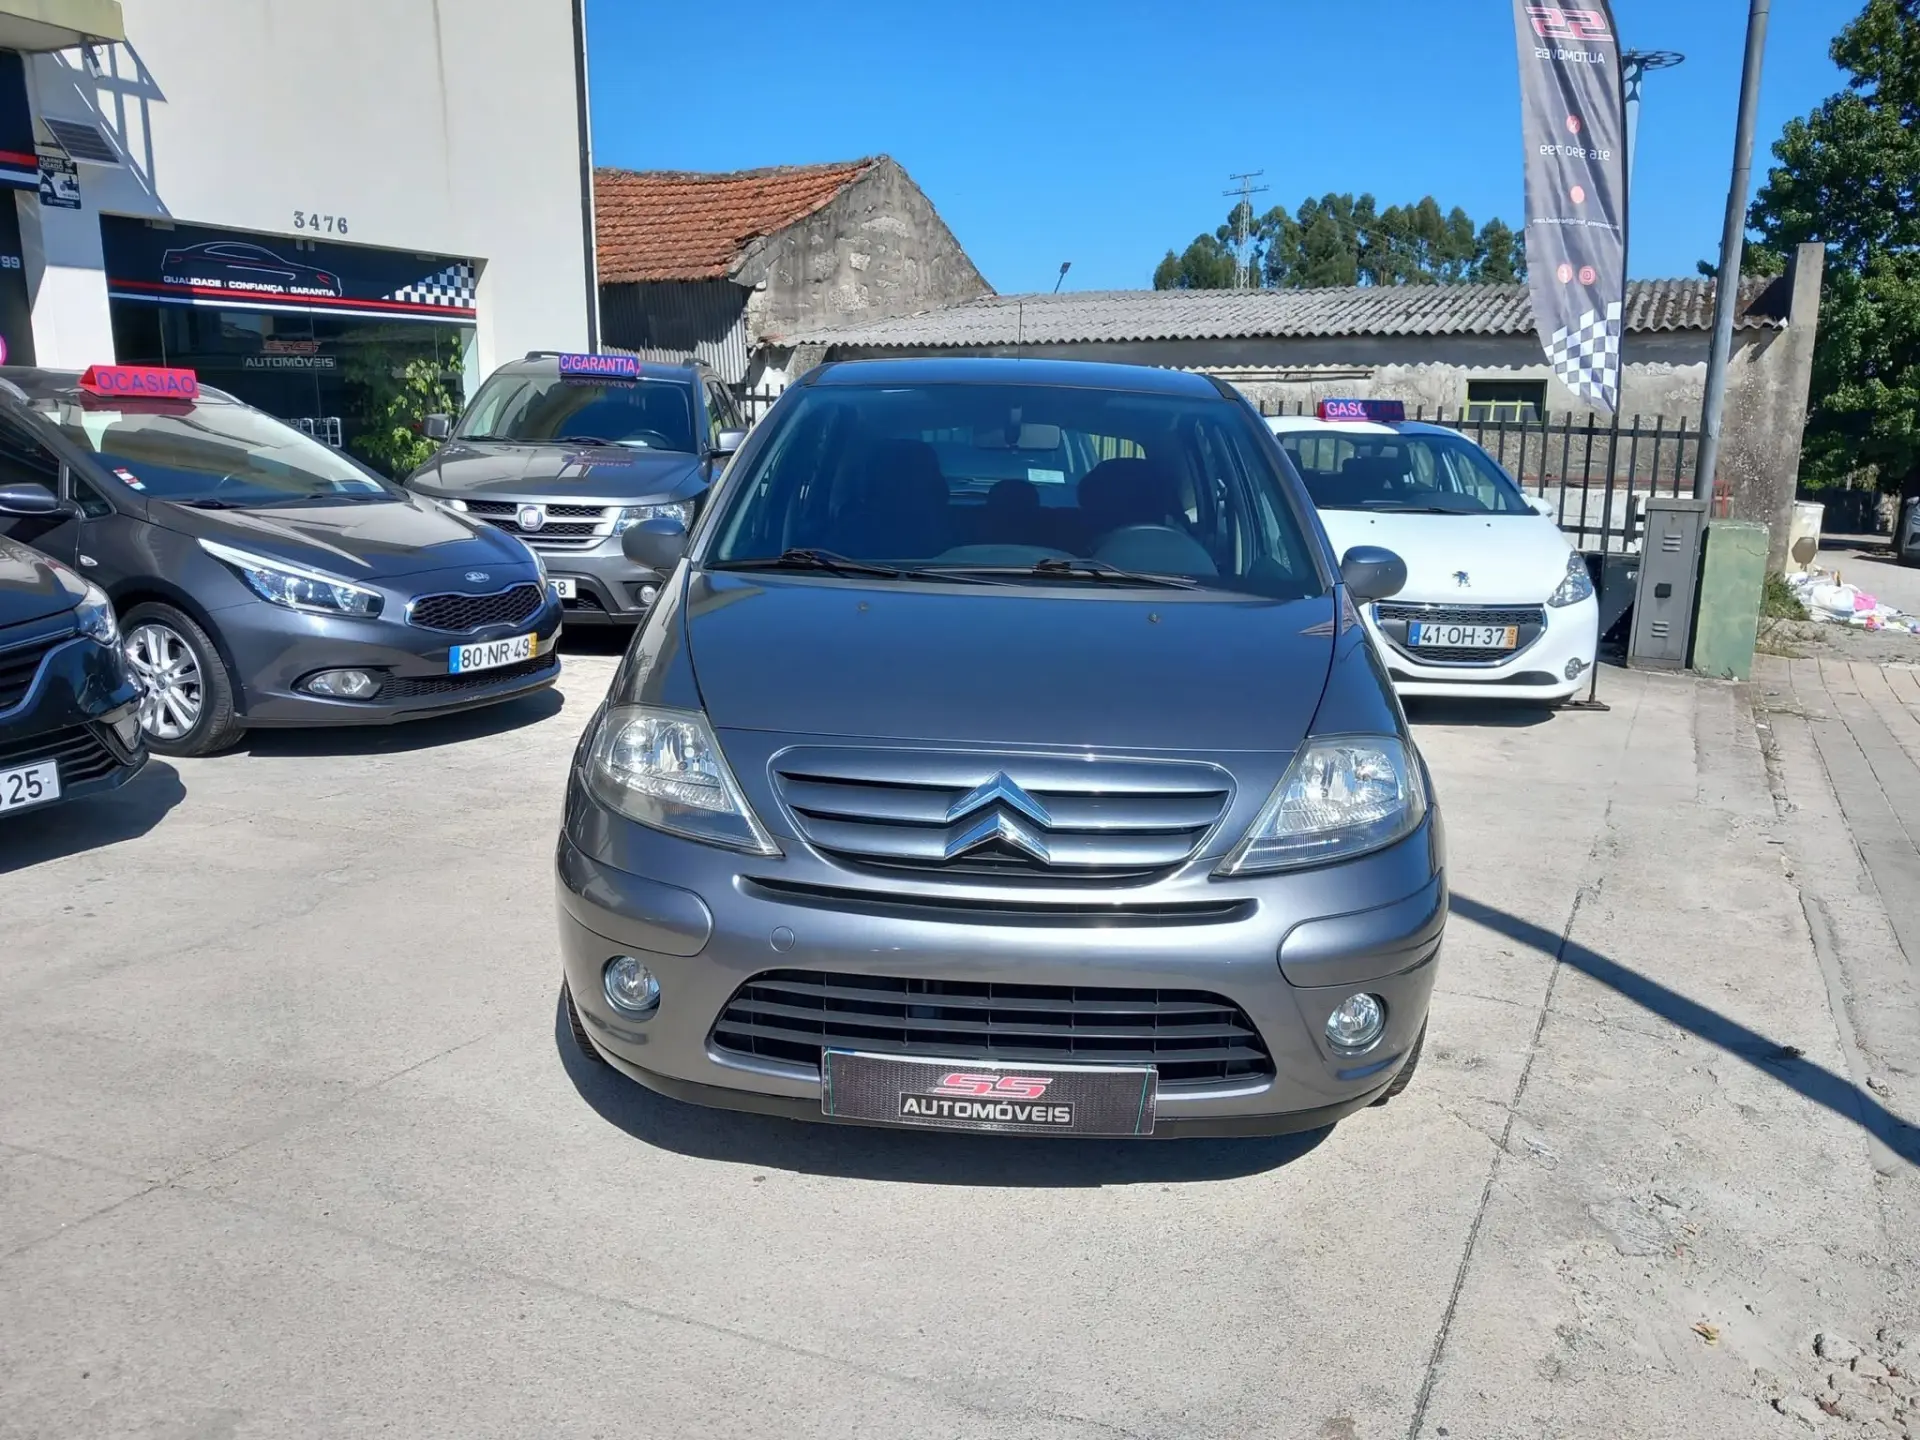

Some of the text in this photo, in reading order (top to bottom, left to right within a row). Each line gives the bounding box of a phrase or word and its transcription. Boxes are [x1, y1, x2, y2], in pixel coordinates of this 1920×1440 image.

[294, 210, 348, 234] 3476
[0, 255, 20, 268] 99
[163, 275, 336, 297] QUALIDADE CONFIANÇA GARANTIA
[245, 355, 334, 368] AUTOMÓVEIS
[560, 355, 636, 374] C/GARANTIA
[902, 1097, 1070, 1122] AUTOMÓVEIS
